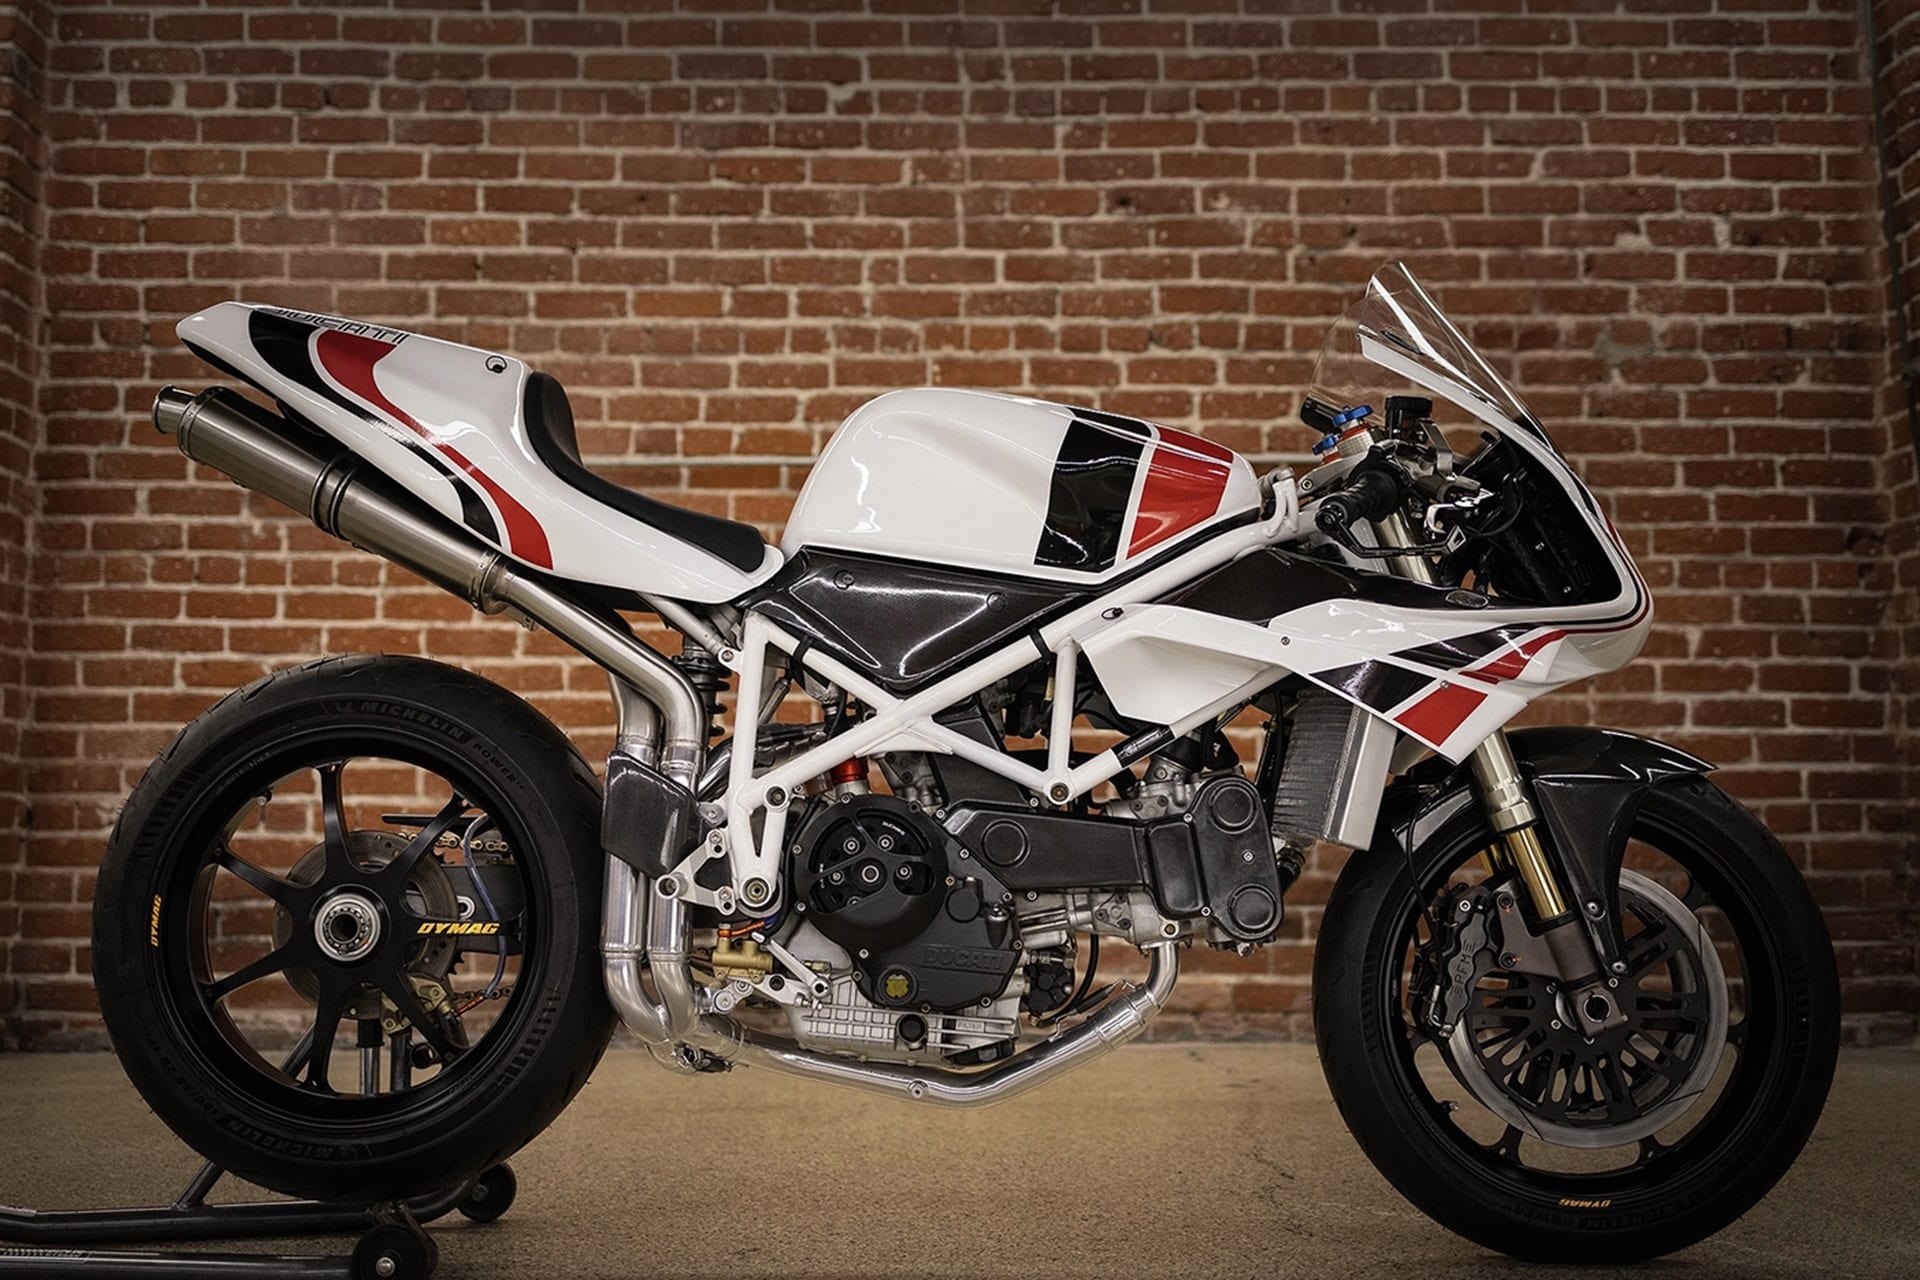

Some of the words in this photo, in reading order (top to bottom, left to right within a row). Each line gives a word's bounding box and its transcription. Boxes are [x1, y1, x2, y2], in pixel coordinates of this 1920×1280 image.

[360, 701, 464, 742] MICHELIN
[473, 743, 517, 782] POWER
[151, 893, 163, 948] DYMAG
[416, 921, 501, 935] DYMAG
[922, 947, 1004, 970] DUCATI
[1557, 1198, 1612, 1208] DYMAG
